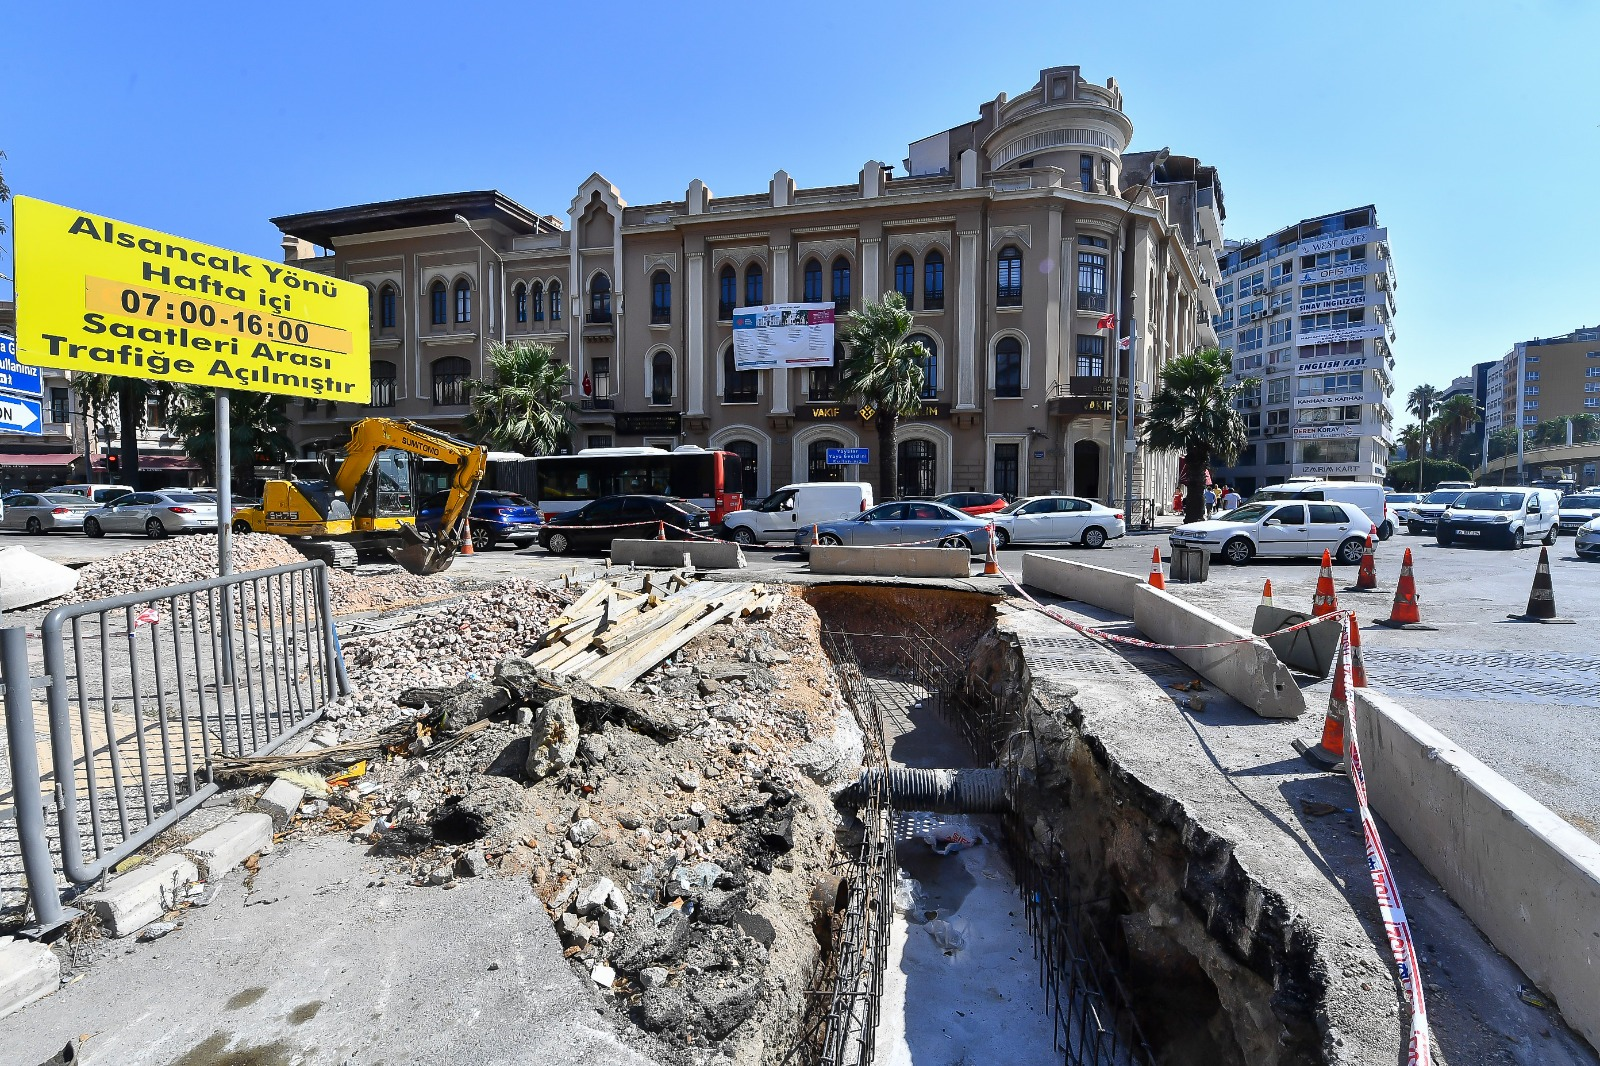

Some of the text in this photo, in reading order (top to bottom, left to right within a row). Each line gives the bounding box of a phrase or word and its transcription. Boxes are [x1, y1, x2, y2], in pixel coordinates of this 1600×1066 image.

[68, 216, 338, 298] Alsancak Yönü
[142, 262, 291, 314] Hafta içi
[83, 312, 331, 370] Saatleri Arası
[121, 289, 309, 344] 07:00-16:00
[42, 333, 356, 395] Trafiğe Açılmıştır
[1298, 361, 1341, 371] ENGLISH
[1343, 358, 1367, 367] FAST
[812, 408, 840, 417] VAKIF
[402, 436, 440, 456] SUMITOMO
